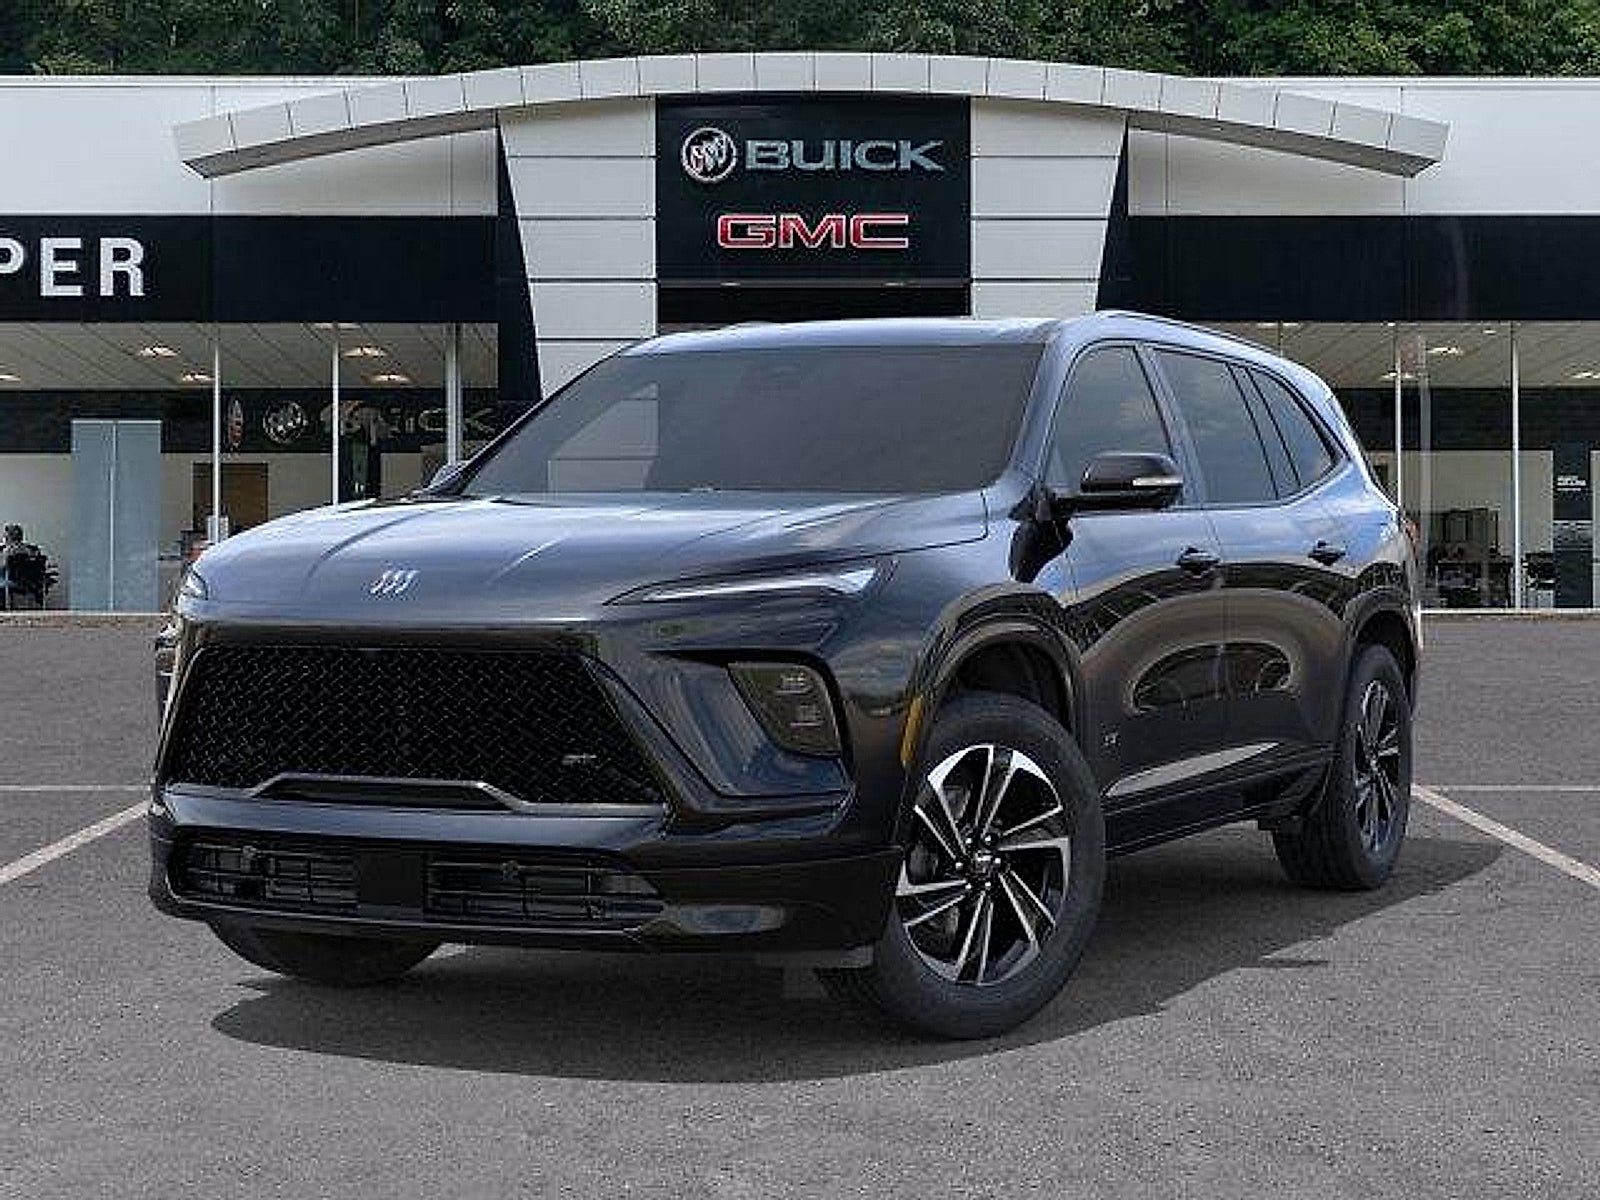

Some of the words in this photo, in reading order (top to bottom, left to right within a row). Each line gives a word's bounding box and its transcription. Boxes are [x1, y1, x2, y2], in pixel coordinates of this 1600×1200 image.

[745, 139, 944, 171] BUICK
[717, 213, 909, 249] GMC
[0, 237, 146, 297] PER
